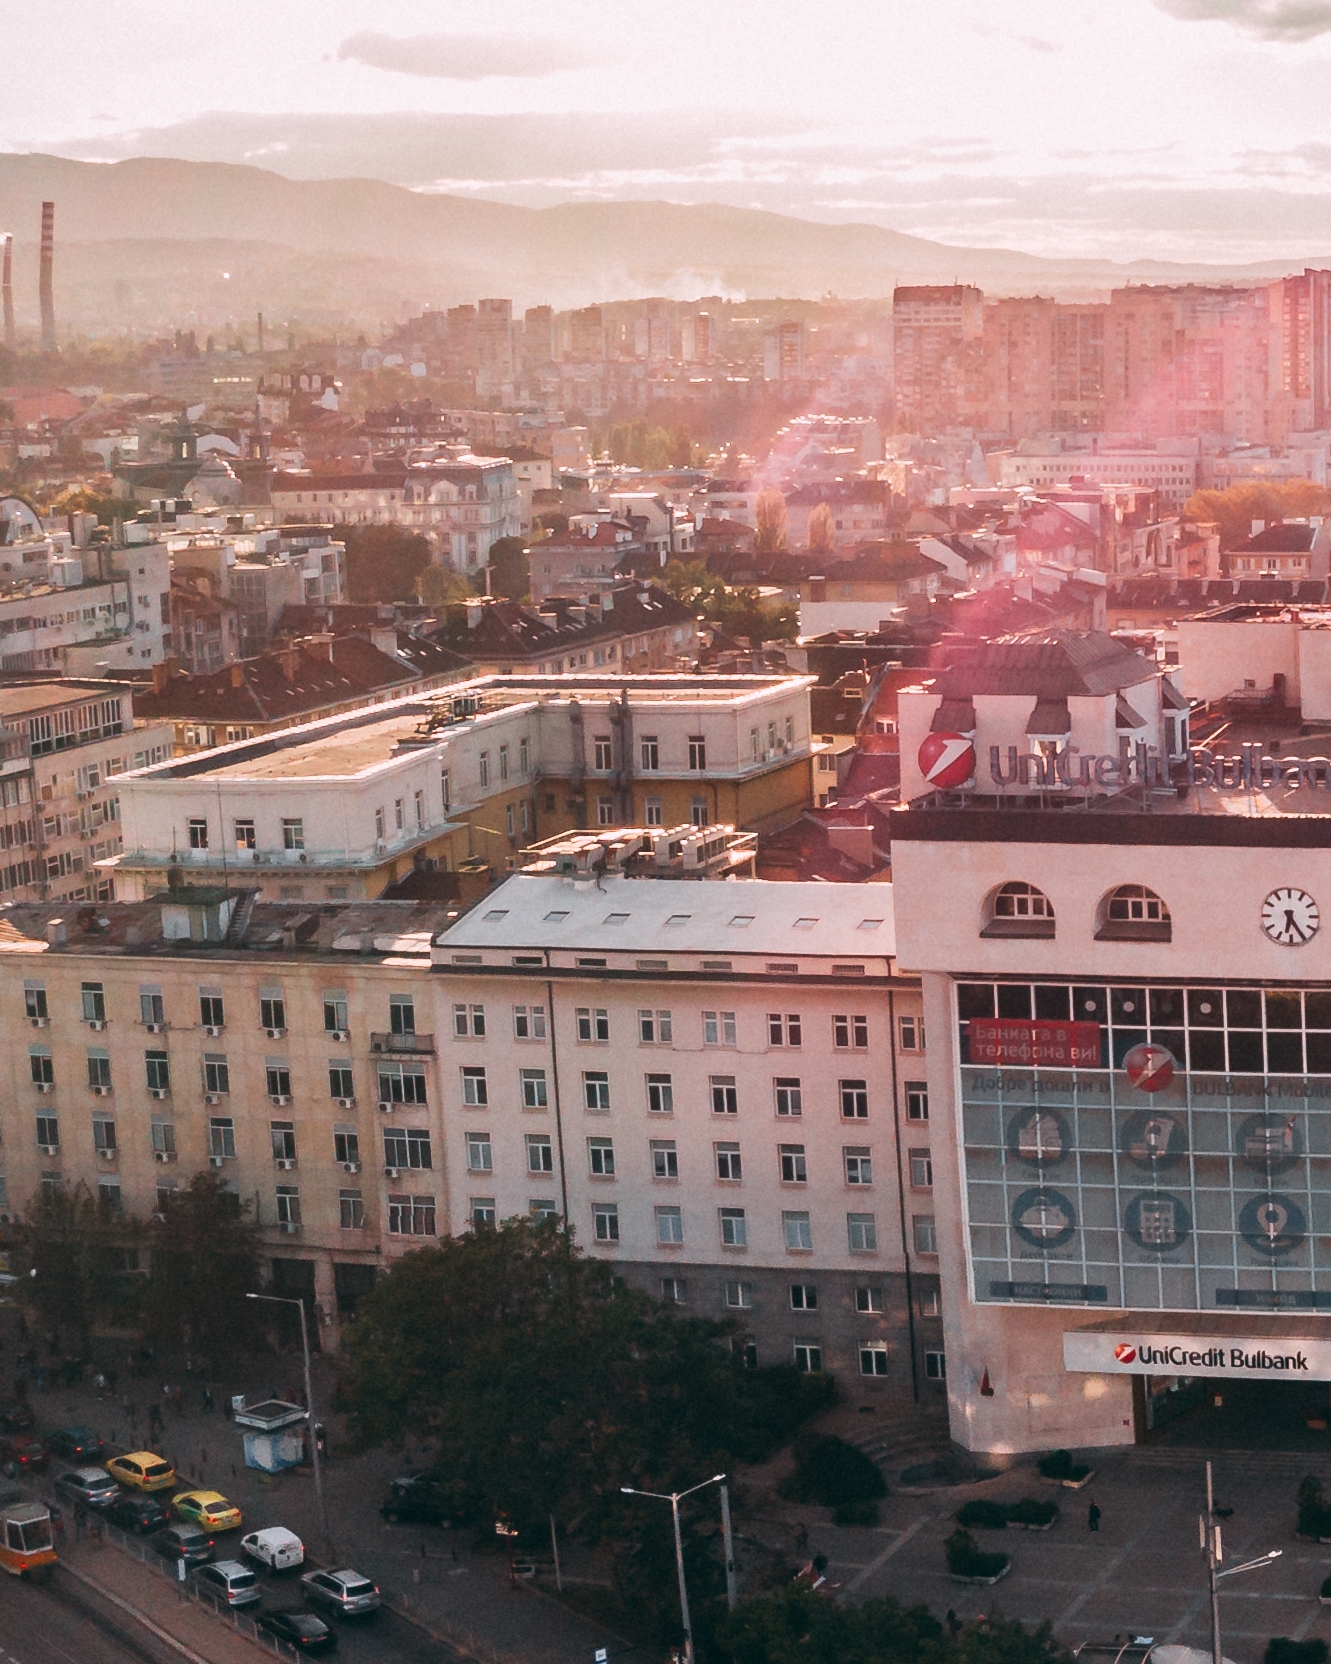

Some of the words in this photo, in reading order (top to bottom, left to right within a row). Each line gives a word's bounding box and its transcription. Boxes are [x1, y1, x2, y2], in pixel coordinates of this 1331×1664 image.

[989, 743, 1177, 787] UniCredit
[976, 1044, 1065, 1060] телефона
[1070, 1047, 1096, 1060] ви!
[972, 1076, 1026, 1092] Добре
[1138, 1345, 1225, 1367] UniCredit
[1230, 1348, 1308, 1370] Bulbank
